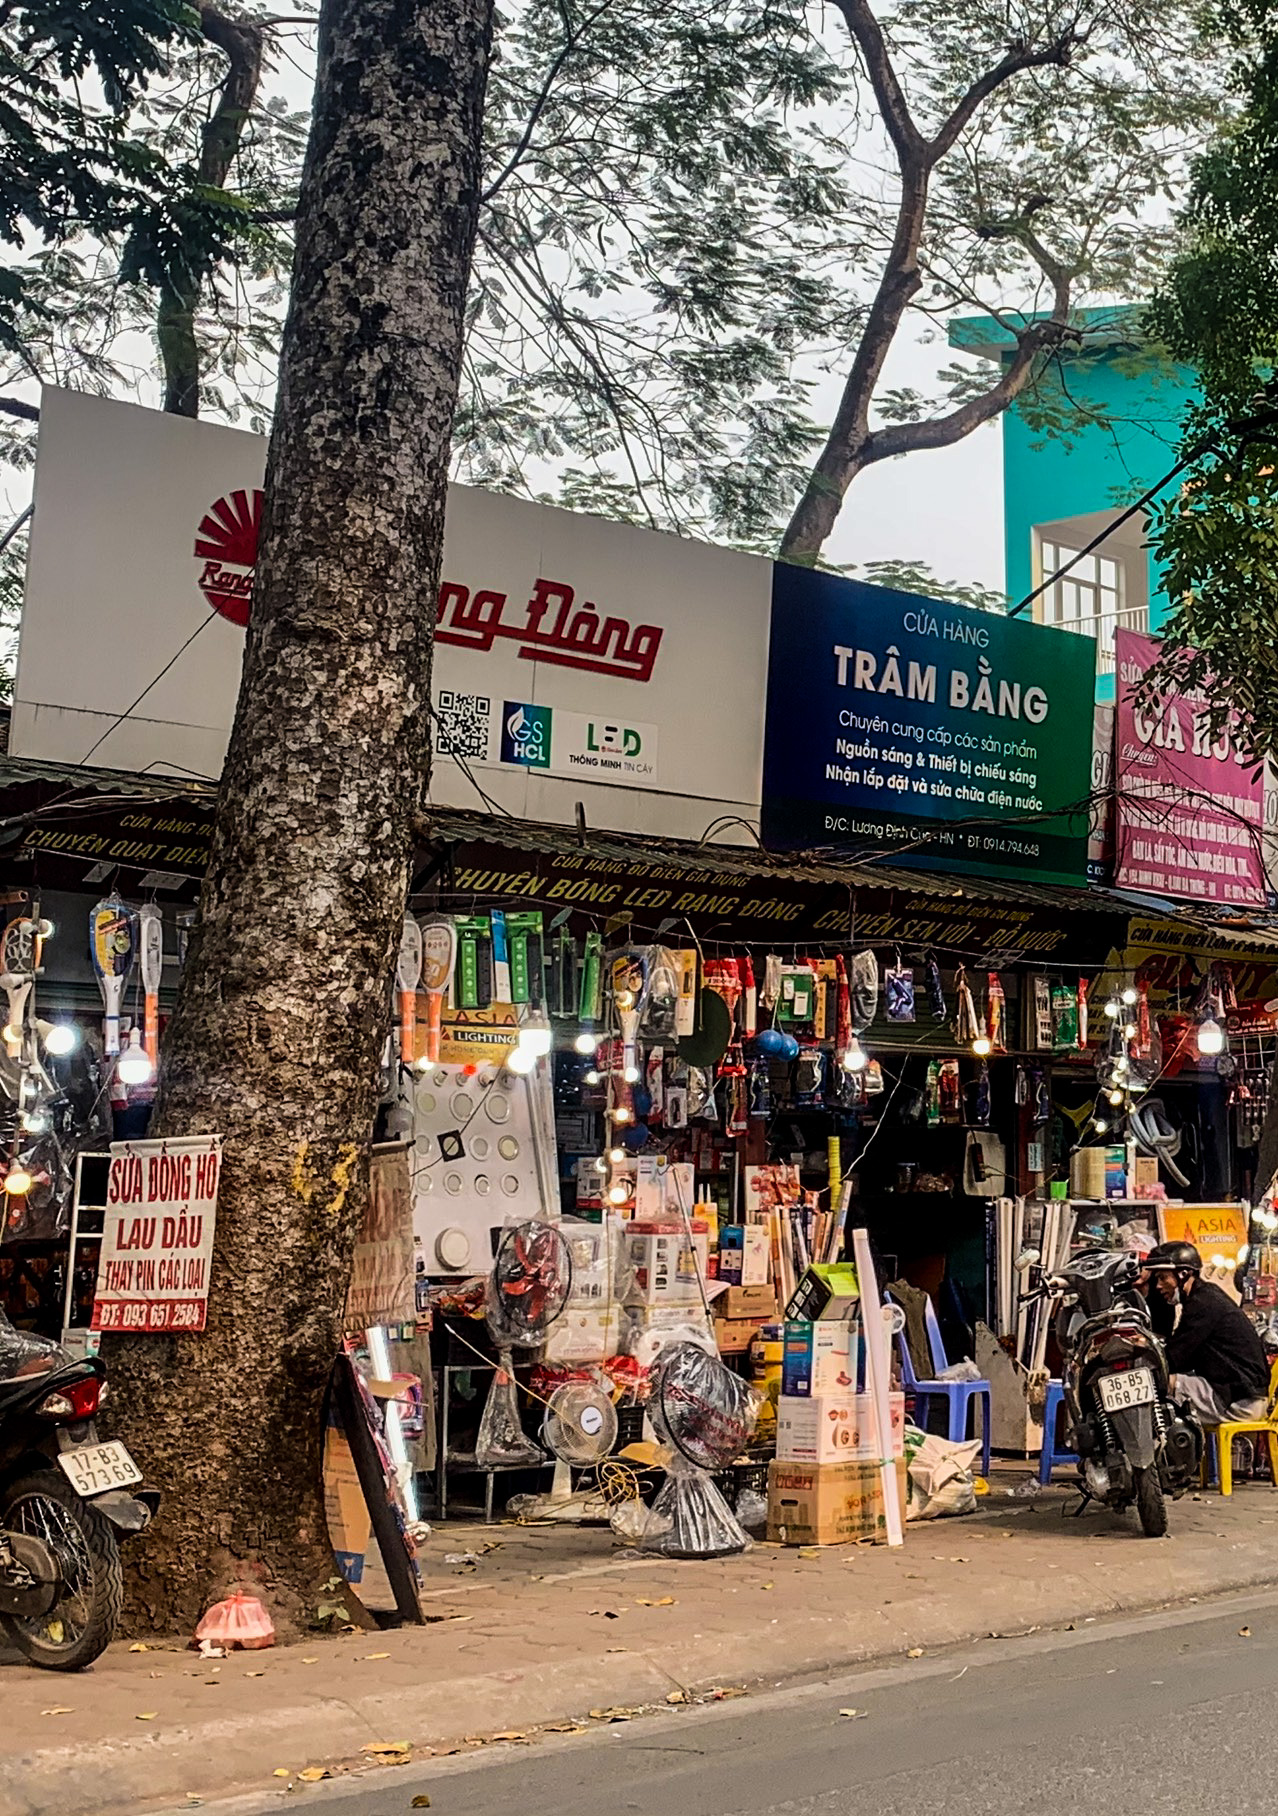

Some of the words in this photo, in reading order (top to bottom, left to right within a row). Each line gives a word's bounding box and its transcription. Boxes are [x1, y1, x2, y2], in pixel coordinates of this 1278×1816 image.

[434, 581, 507, 651] ng
[903, 608, 939, 639] CỬA
[943, 619, 990, 648] HÀNG
[833, 645, 937, 703] TRÂM
[949, 655, 1049, 724] BẰNG
[513, 742, 546, 761] HCL
[587, 723, 642, 757] LED
[839, 709, 889, 733] Chuyên
[891, 722, 924, 743] cung
[927, 726, 952, 747] cấp
[954, 732, 979, 749] các
[980, 734, 1001, 753] sản
[1003, 739, 1038, 760] phẩm
[569, 754, 599, 767] THÔNG
[600, 758, 622, 770] MINH
[624, 761, 635, 772] TIN
[836, 738, 879, 760] Nguồn
[881, 746, 913, 769] sáng
[916, 752, 925, 767] &
[929, 753, 957, 772] Thiết
[960, 759, 972, 779] bị
[974, 762, 1006, 781] chiếu
[1009, 769, 1037, 789] sáng
[826, 763, 859, 787] Nhận
[863, 767, 884, 789] lắp
[887, 775, 909, 794] đặt
[912, 777, 928, 794] và
[930, 779, 952, 798] sửa
[955, 785, 985, 802] chữa
[987, 791, 1012, 809] điện
[1015, 795, 1043, 811] nước
[119, 811, 154, 828] CỬA
[153, 818, 196, 834] HÀNG
[825, 815, 849, 831] Đ/C:
[852, 819, 884, 839] Lương
[940, 834, 954, 846] HN
[967, 835, 982, 849] ĐT:
[24, 829, 109, 854] CHUYÊN
[109, 840, 166, 862] QUẠT
[552, 854, 582, 869] CỬA
[584, 858, 627, 875] HÀNG
[686, 868, 708, 884] GIA
[709, 872, 750, 889] DỤNG
[546, 877, 623, 903] BÓNG
[623, 887, 673, 908] LED
[738, 896, 805, 922] ĐÔNG
[812, 909, 902, 936] CHUYÊN
[894, 918, 943, 940] SEN
[940, 921, 976, 944] VÒI
[1013, 928, 1068, 950] NƯỚC
[1130, 924, 1153, 941] CỬA
[1150, 928, 1183, 945] HÀNG
[455, 1010, 516, 1025] ASIA
[457, 1031, 516, 1044] LIGHTING
[109, 1143, 142, 1205] SỬA
[148, 1141, 191, 1202] ĐỒNG
[196, 1138, 217, 1200] HỒ
[117, 1217, 156, 1250] LAU
[1198, 1218, 1236, 1231] ASIA
[106, 1260, 134, 1291] THAY
[136, 1259, 155, 1291] PIN
[158, 1252, 181, 1290] CÁC
[182, 1257, 205, 1297] LOẠI
[100, 1304, 120, 1327] ĐT:
[122, 1304, 147, 1327] 093
[149, 1304, 170, 1326] 651
[1106, 1386, 1149, 1408] 068.27
